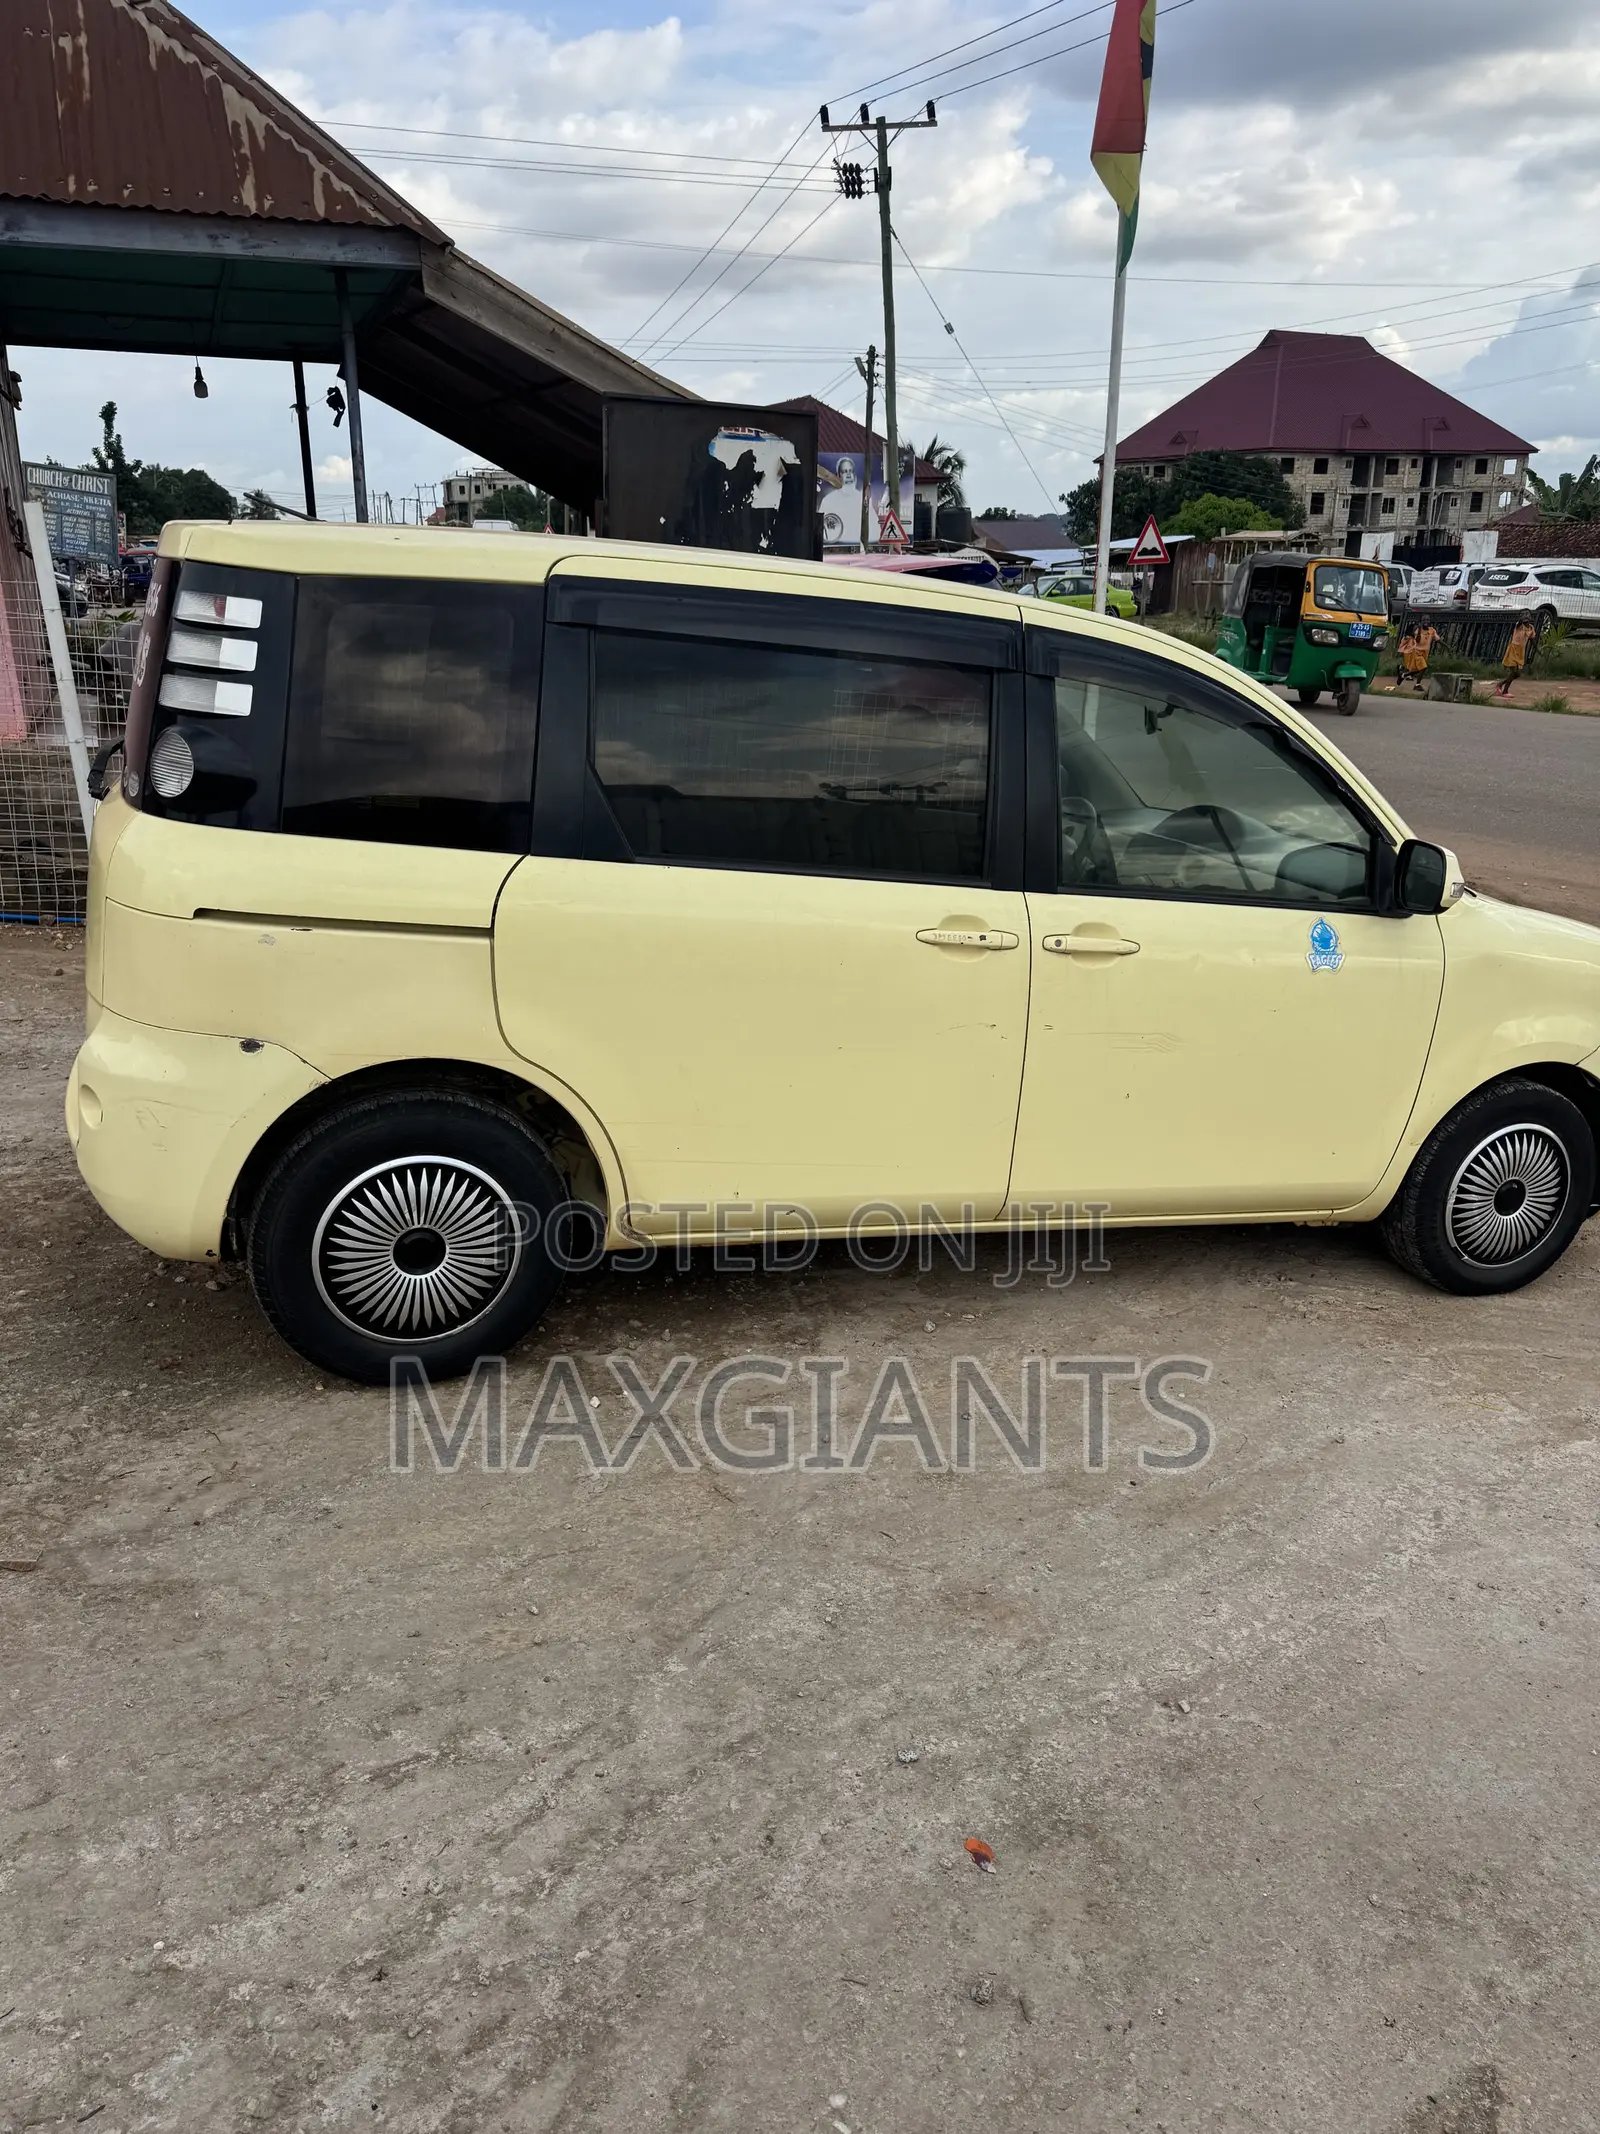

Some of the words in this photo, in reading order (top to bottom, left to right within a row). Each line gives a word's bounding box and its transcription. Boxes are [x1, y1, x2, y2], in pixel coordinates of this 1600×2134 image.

[27, 467, 62, 487] CHURCH
[72, 474, 110, 494] CHRIST
[1309, 953, 1343, 970] EAGLES
